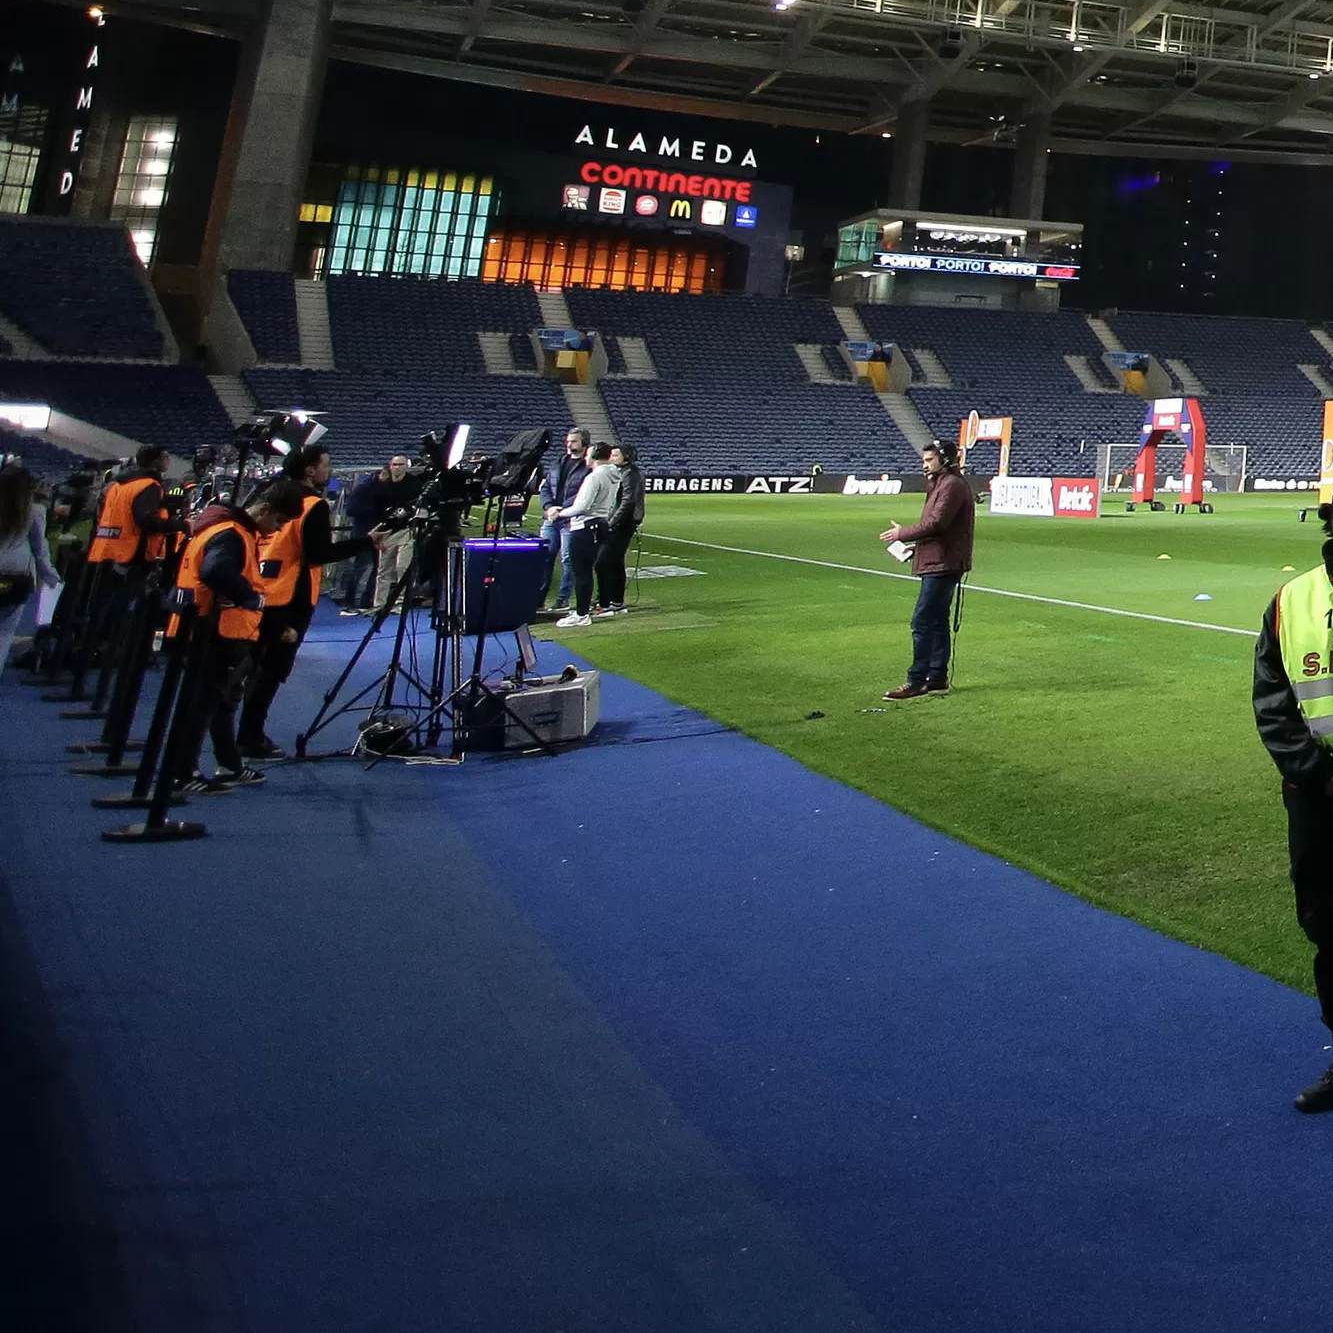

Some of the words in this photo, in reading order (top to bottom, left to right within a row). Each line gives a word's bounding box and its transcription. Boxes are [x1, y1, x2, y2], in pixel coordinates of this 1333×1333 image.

[575, 124, 758, 168] ALAMEDA
[581, 162, 752, 203] CONTINENTE
[935, 258, 985, 272] PORTO!
[842, 473, 902, 495] bwin
